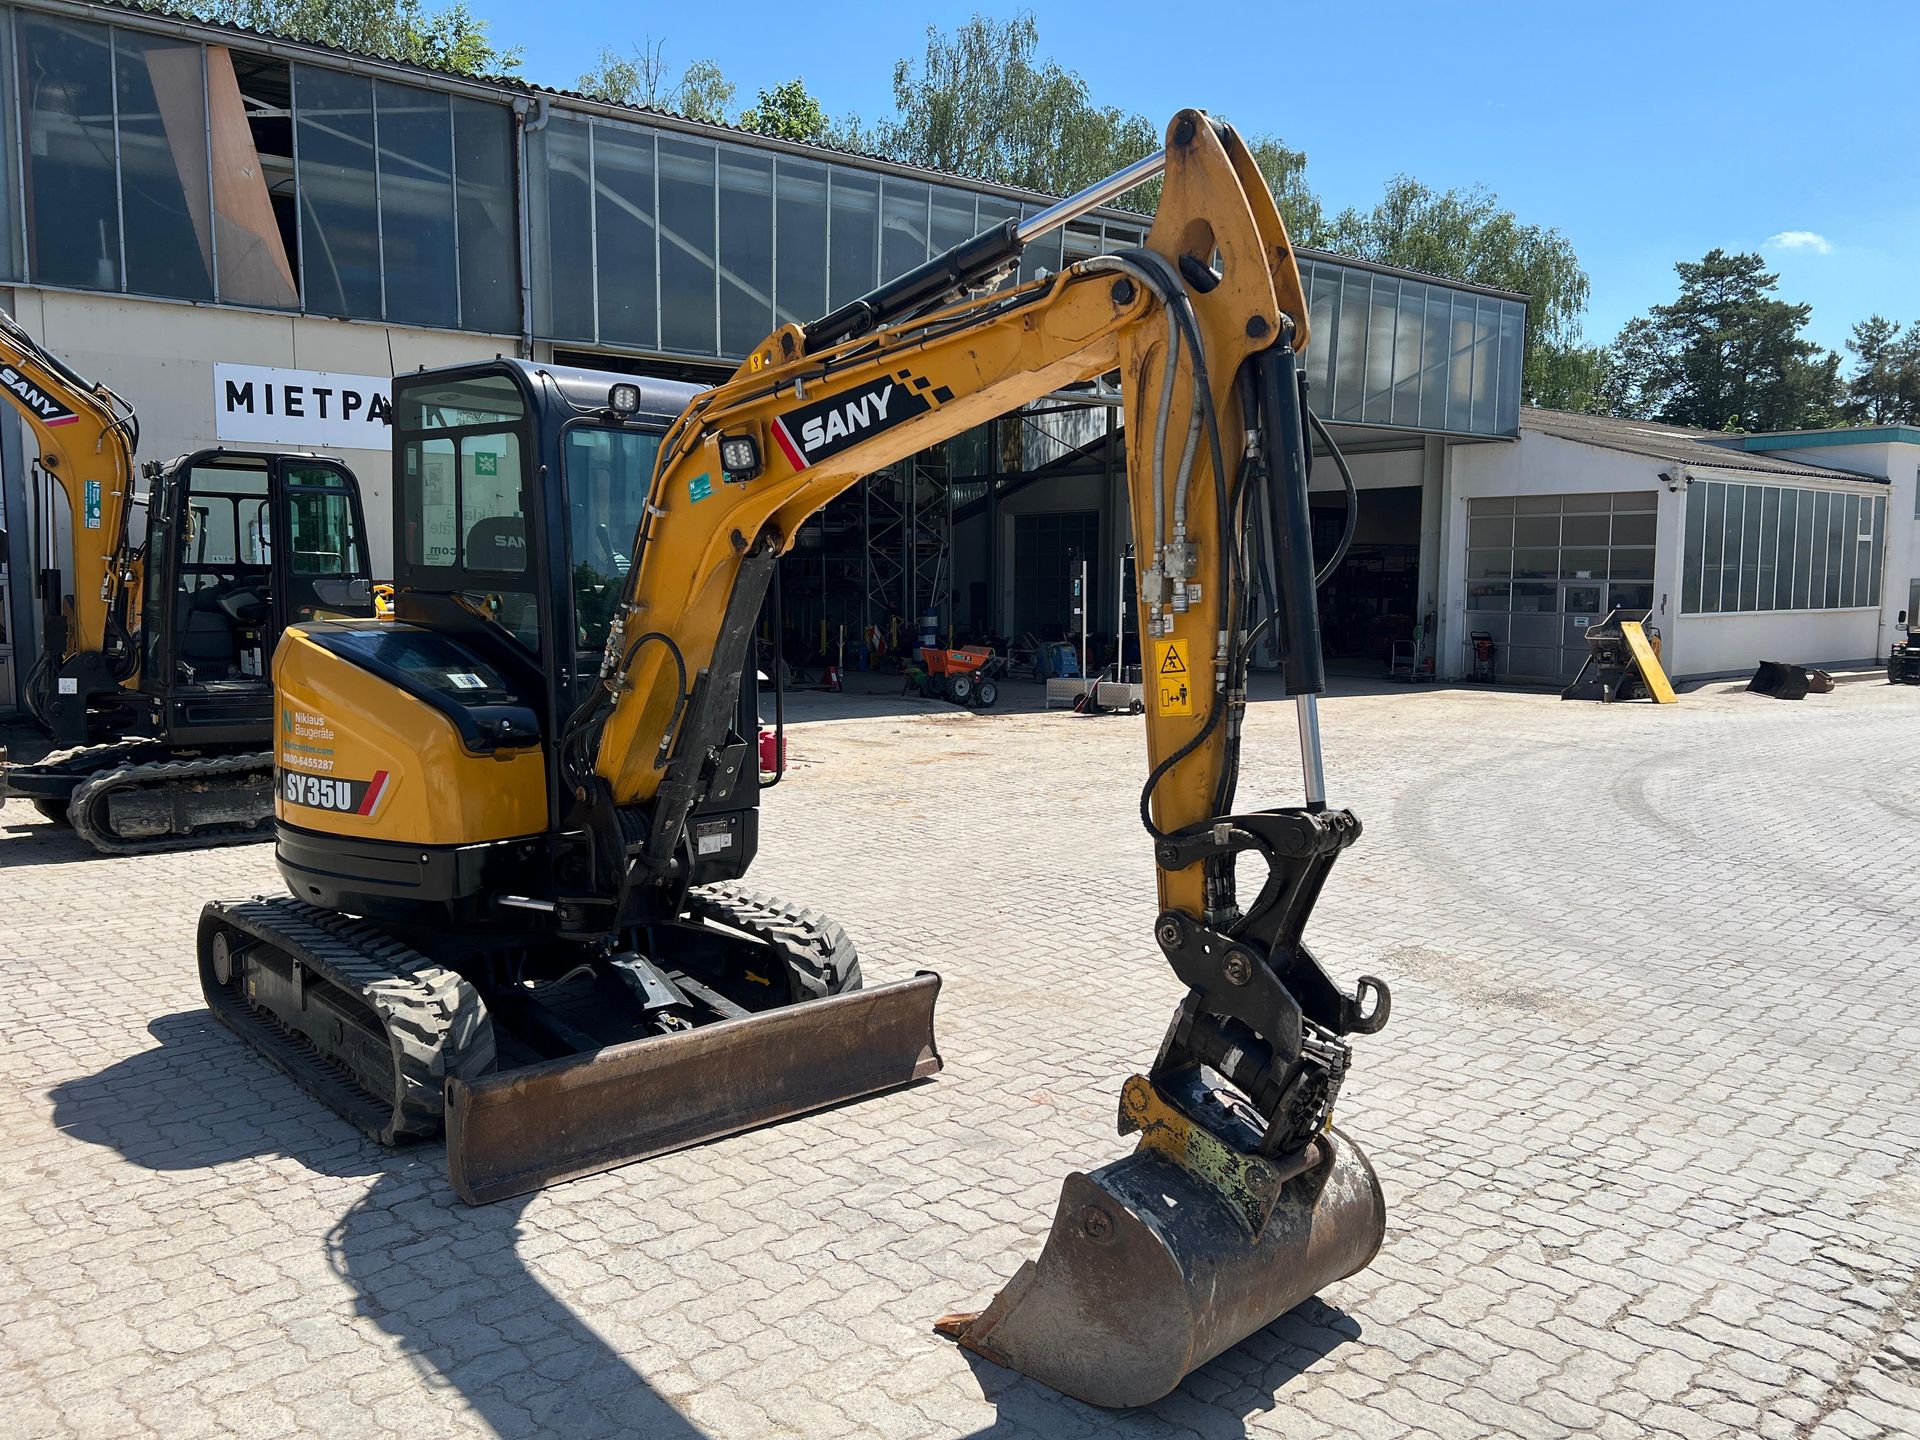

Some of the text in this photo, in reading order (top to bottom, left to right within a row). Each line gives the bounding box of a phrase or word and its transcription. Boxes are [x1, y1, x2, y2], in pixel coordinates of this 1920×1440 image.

[0, 368, 59, 415] SANY
[801, 384, 893, 453] SANY
[295, 711, 324, 726] Niklaus
[295, 723, 334, 740] Baugeräte
[287, 773, 352, 811] SY35U
